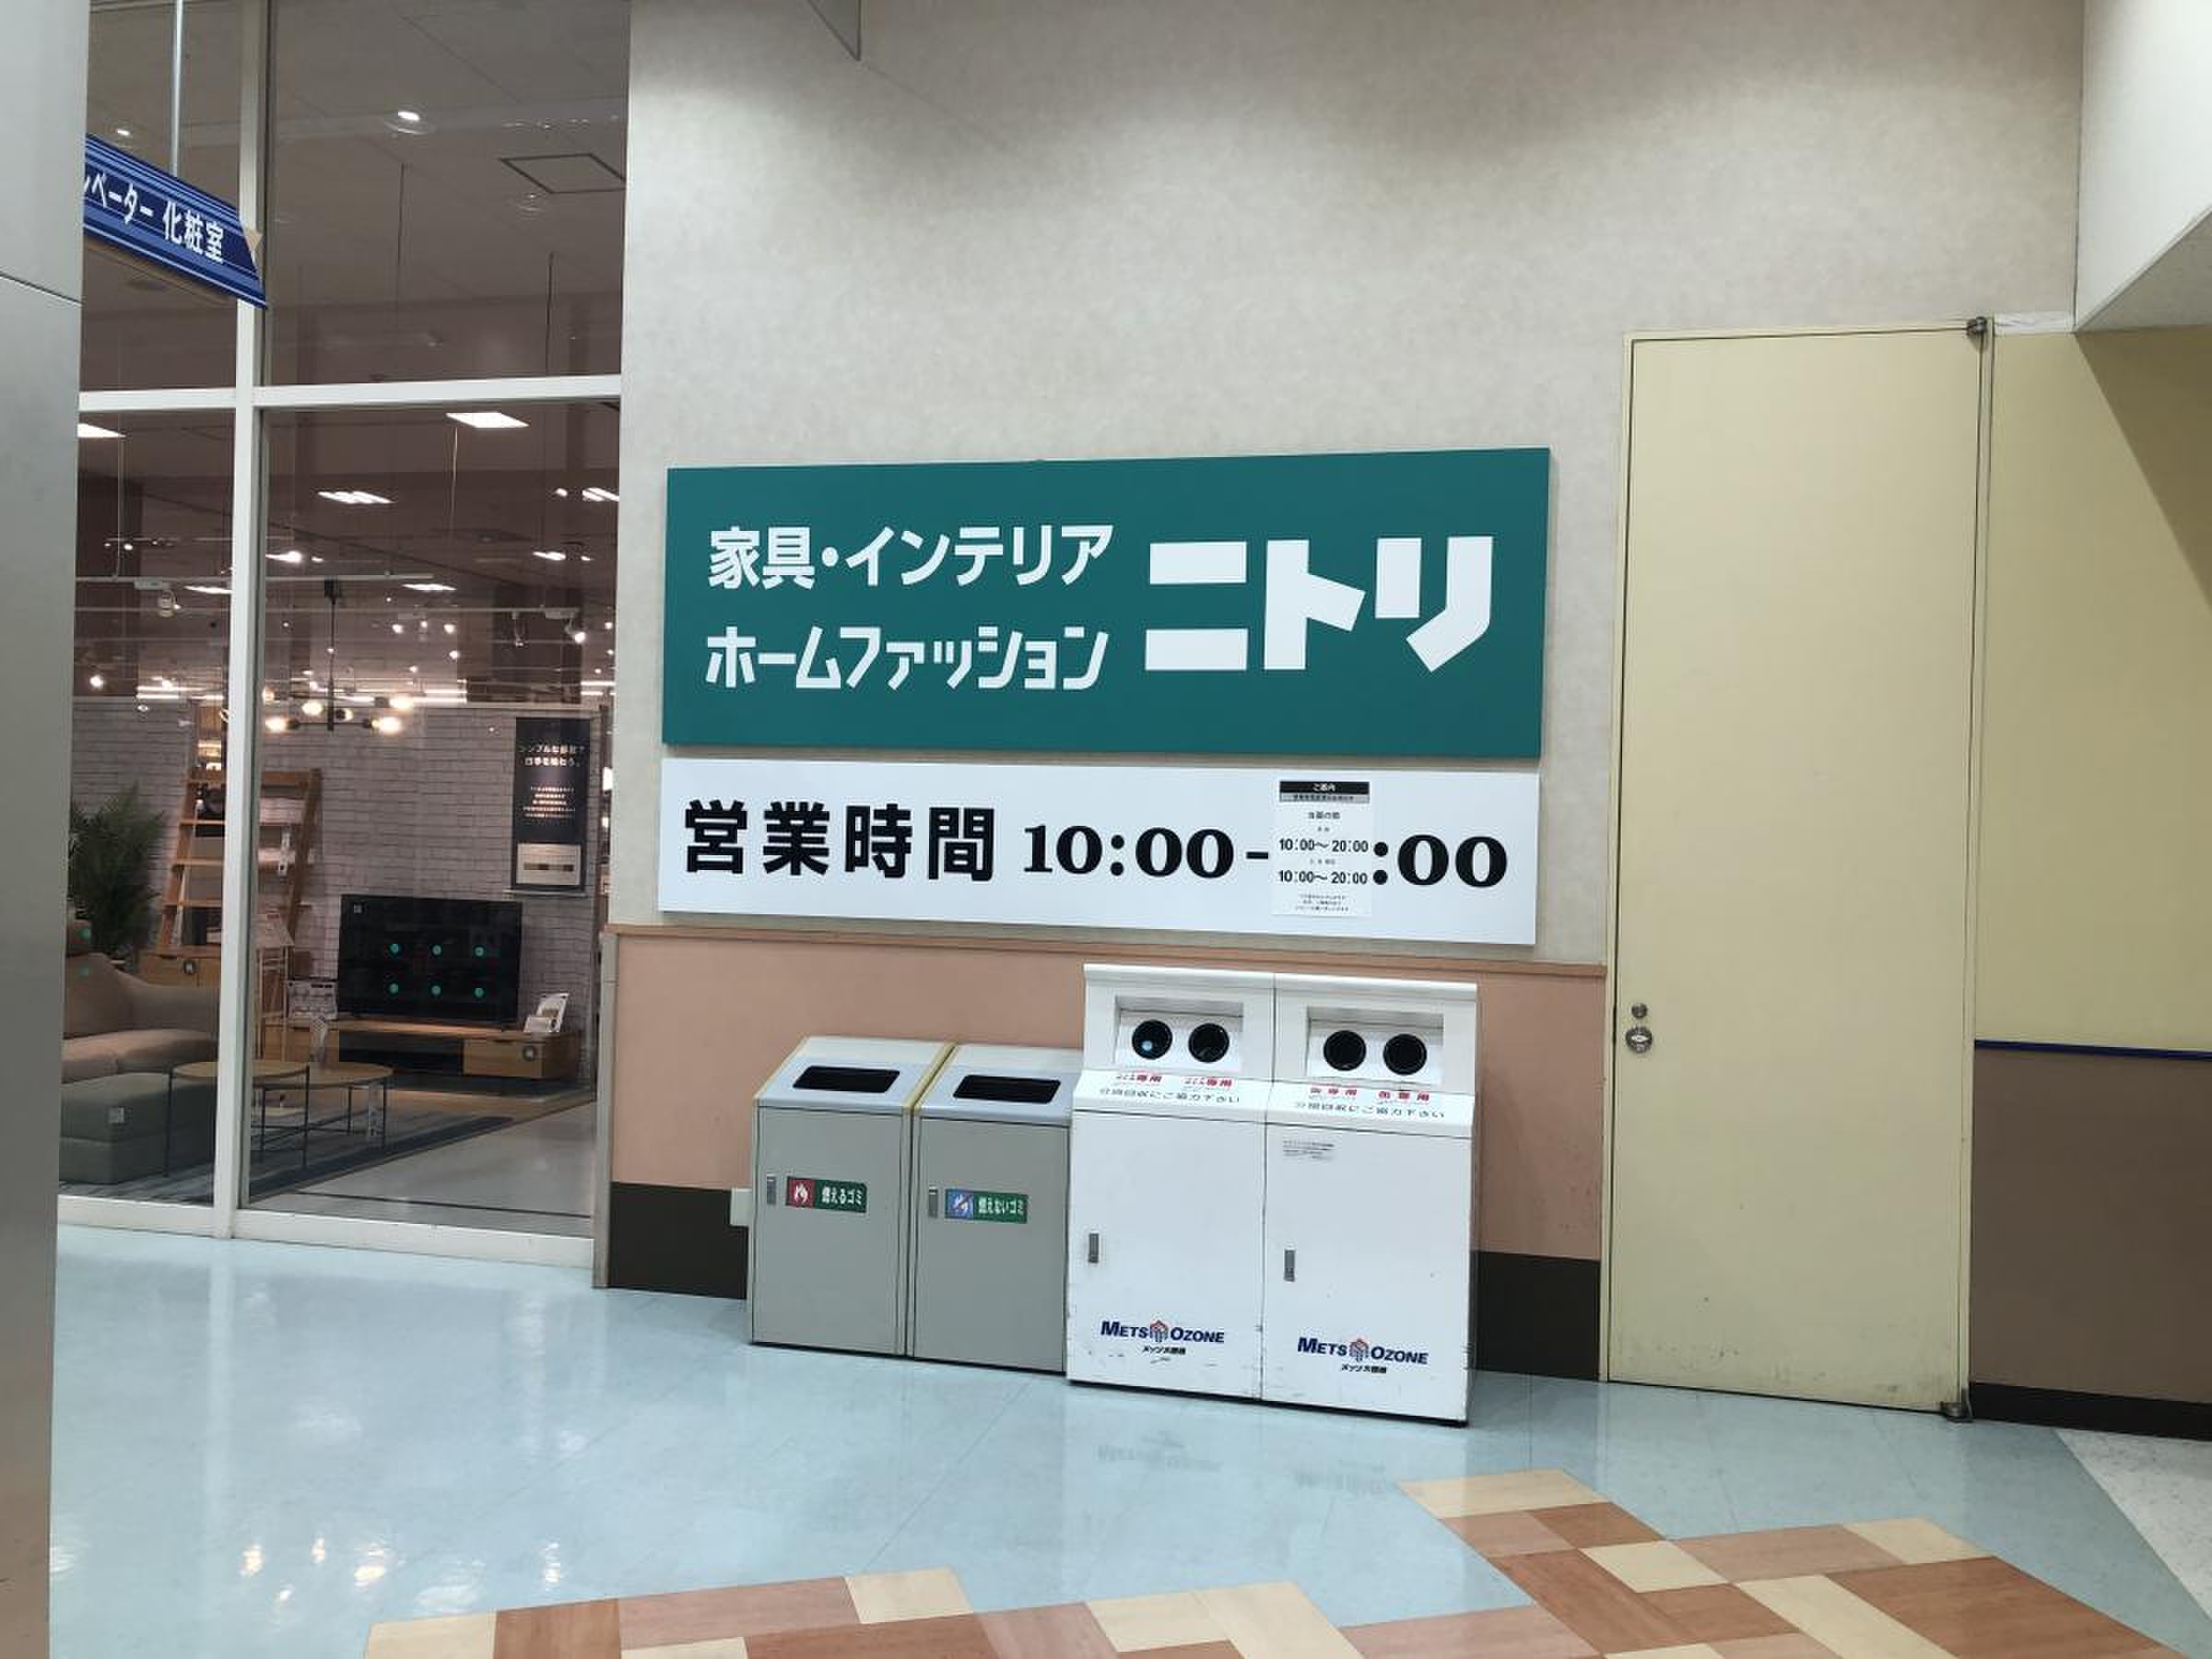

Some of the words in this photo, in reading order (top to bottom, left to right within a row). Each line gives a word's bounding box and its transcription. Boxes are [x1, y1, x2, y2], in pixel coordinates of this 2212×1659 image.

[162, 200, 224, 264] 化粧室
[708, 524, 1113, 590] 家具・インテリア
[1145, 535, 1494, 673] ニトリ
[705, 626, 1109, 690] ホームファッション
[685, 799, 995, 882] 営業時間
[1100, 1321, 1148, 1339] METS
[1170, 1326, 1225, 1343] OZONE
[1297, 1336, 1347, 1357] METS
[1371, 1346, 1429, 1365] OZONE
